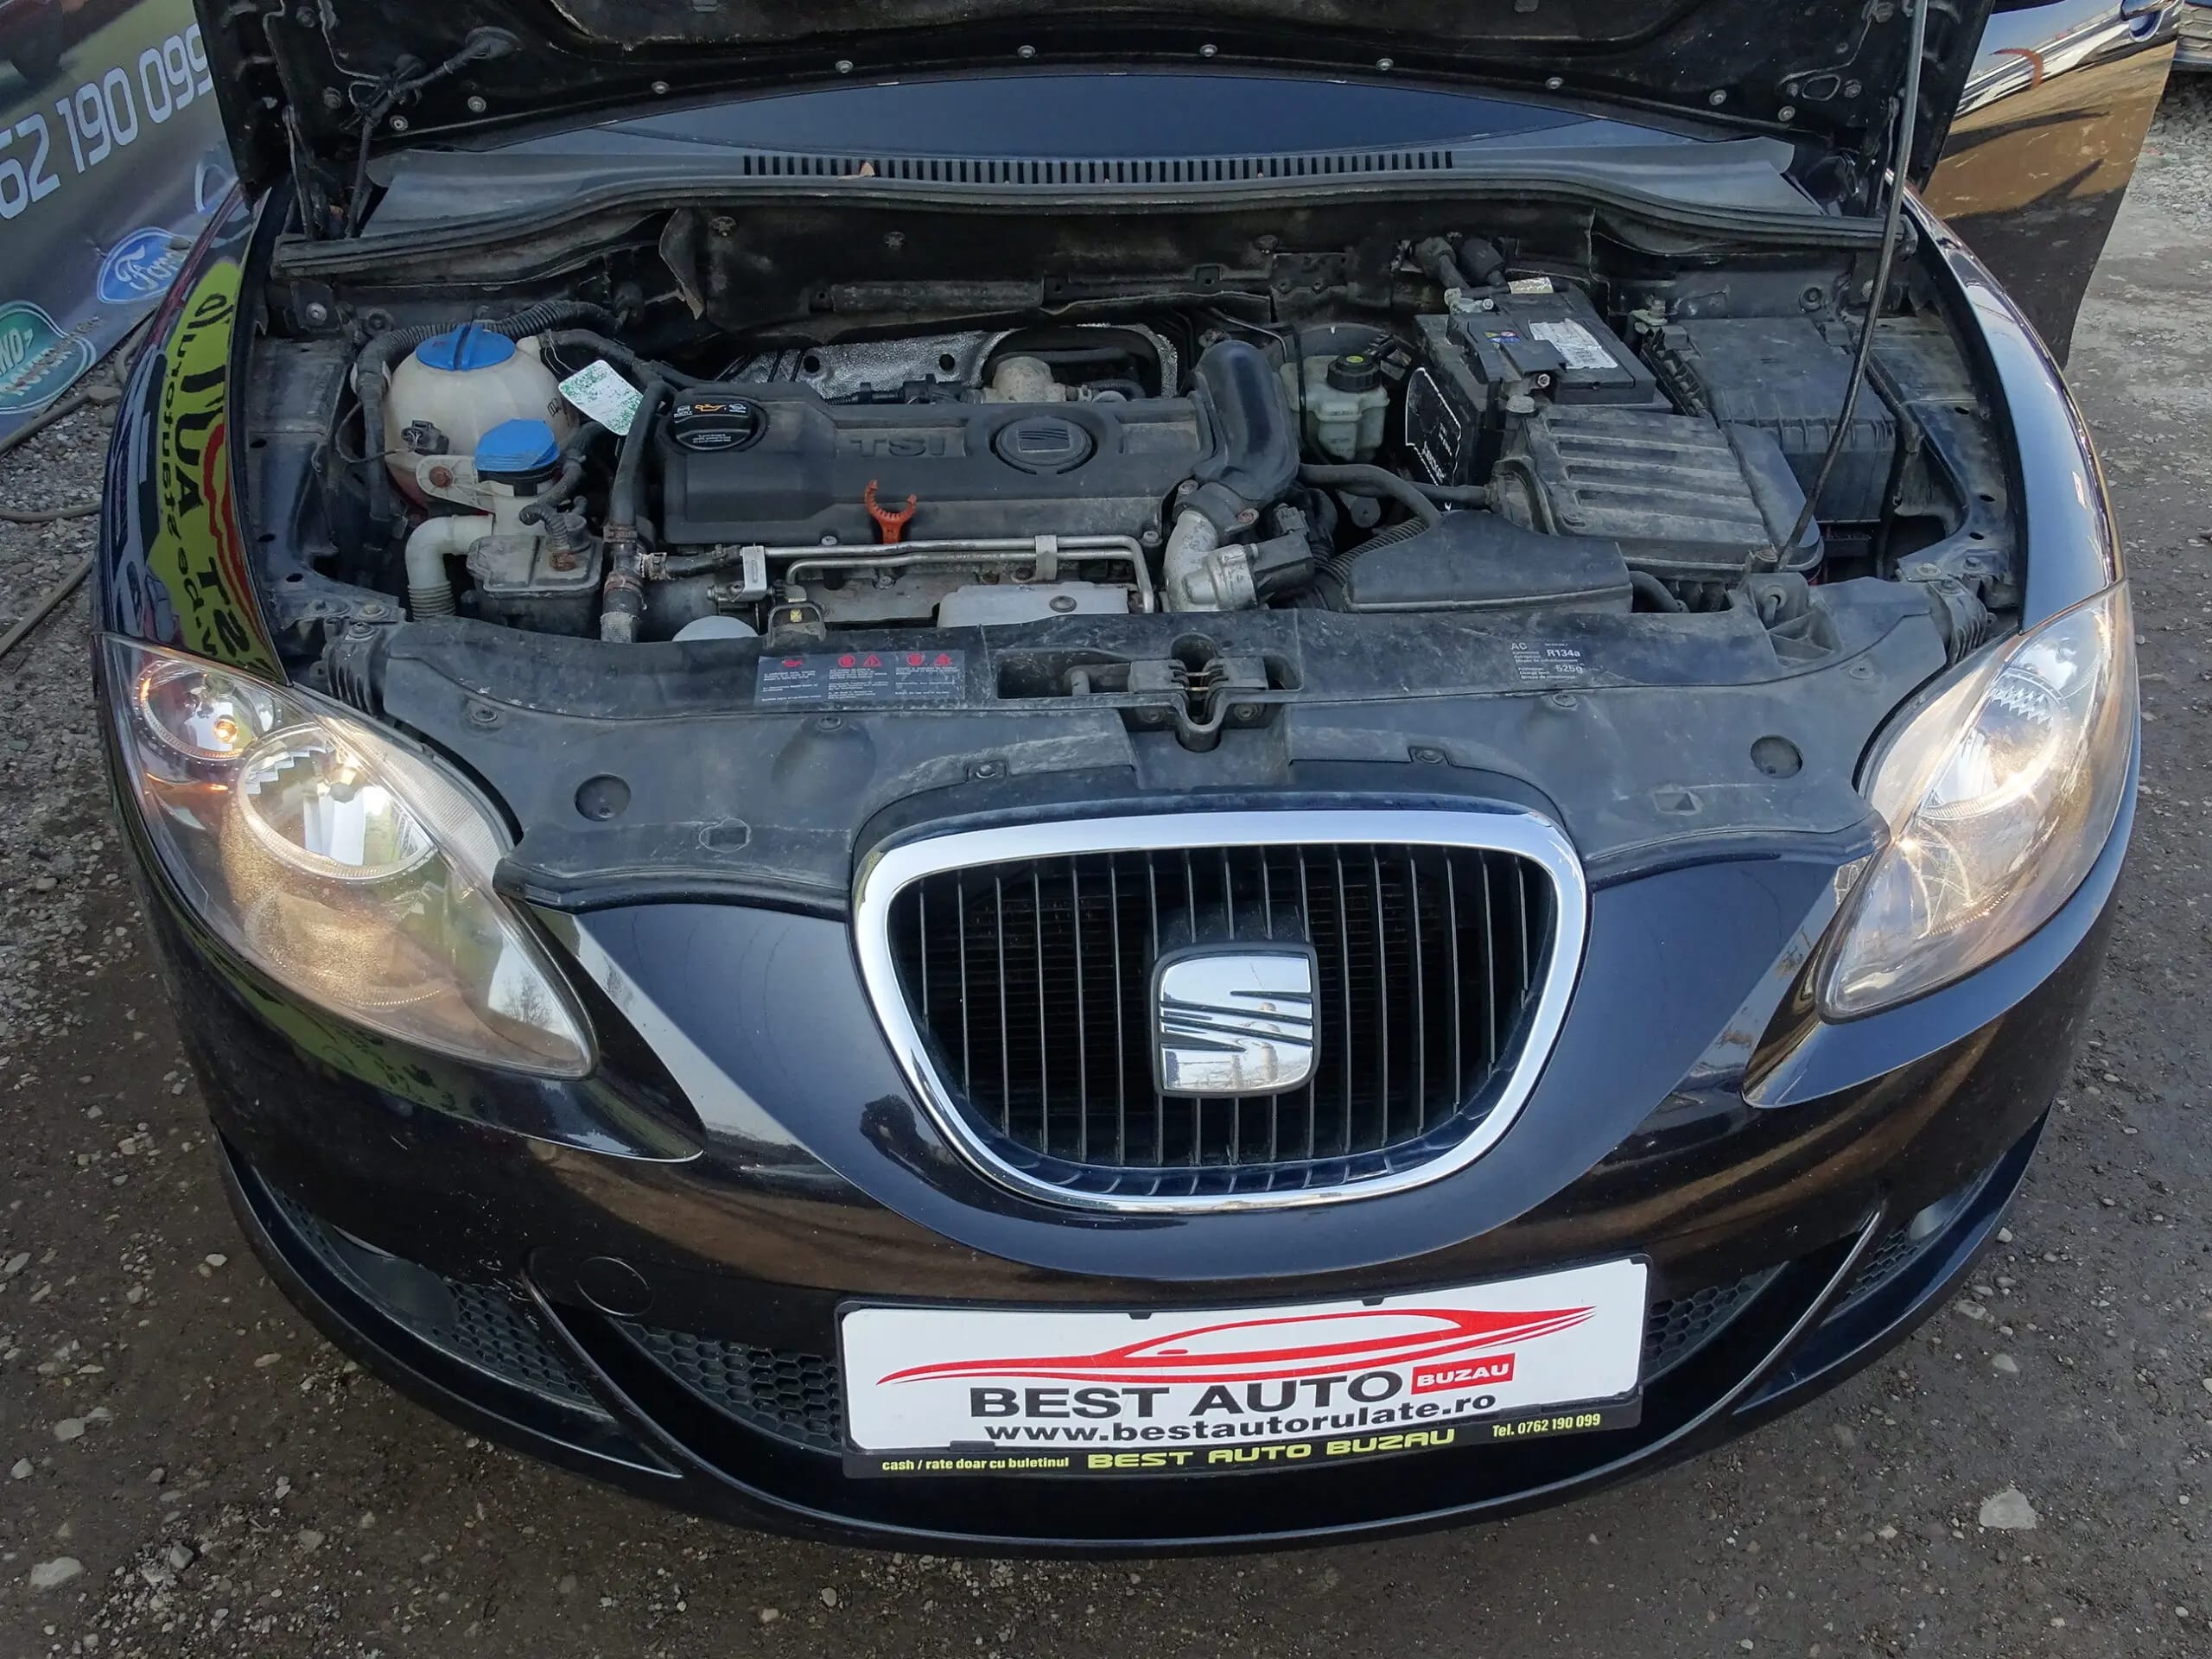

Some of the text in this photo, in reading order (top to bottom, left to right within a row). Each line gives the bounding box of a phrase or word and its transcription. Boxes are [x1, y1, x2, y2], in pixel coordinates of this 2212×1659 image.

[55, 67, 138, 174] 190
[139, 22, 214, 124] 099
[849, 435, 945, 457] TSI
[1511, 642, 1528, 651] AC
[1547, 649, 1581, 658] R134a
[1416, 1363, 1510, 1388] BUZAU
[970, 1370, 1403, 1419] BEST AUTO
[984, 1394, 1497, 1441] www.bestautorulate.ro
[1492, 1413, 1601, 1439] Tel. 0762 190 099
[1087, 1427, 1455, 1469] BEST AUTO BUZAU
[881, 1459, 914, 1471] cash
[925, 1459, 953, 1470] rate
[956, 1458, 988, 1469] doar
[989, 1459, 1006, 1469] cu
[1008, 1457, 1070, 1469] buletinul
